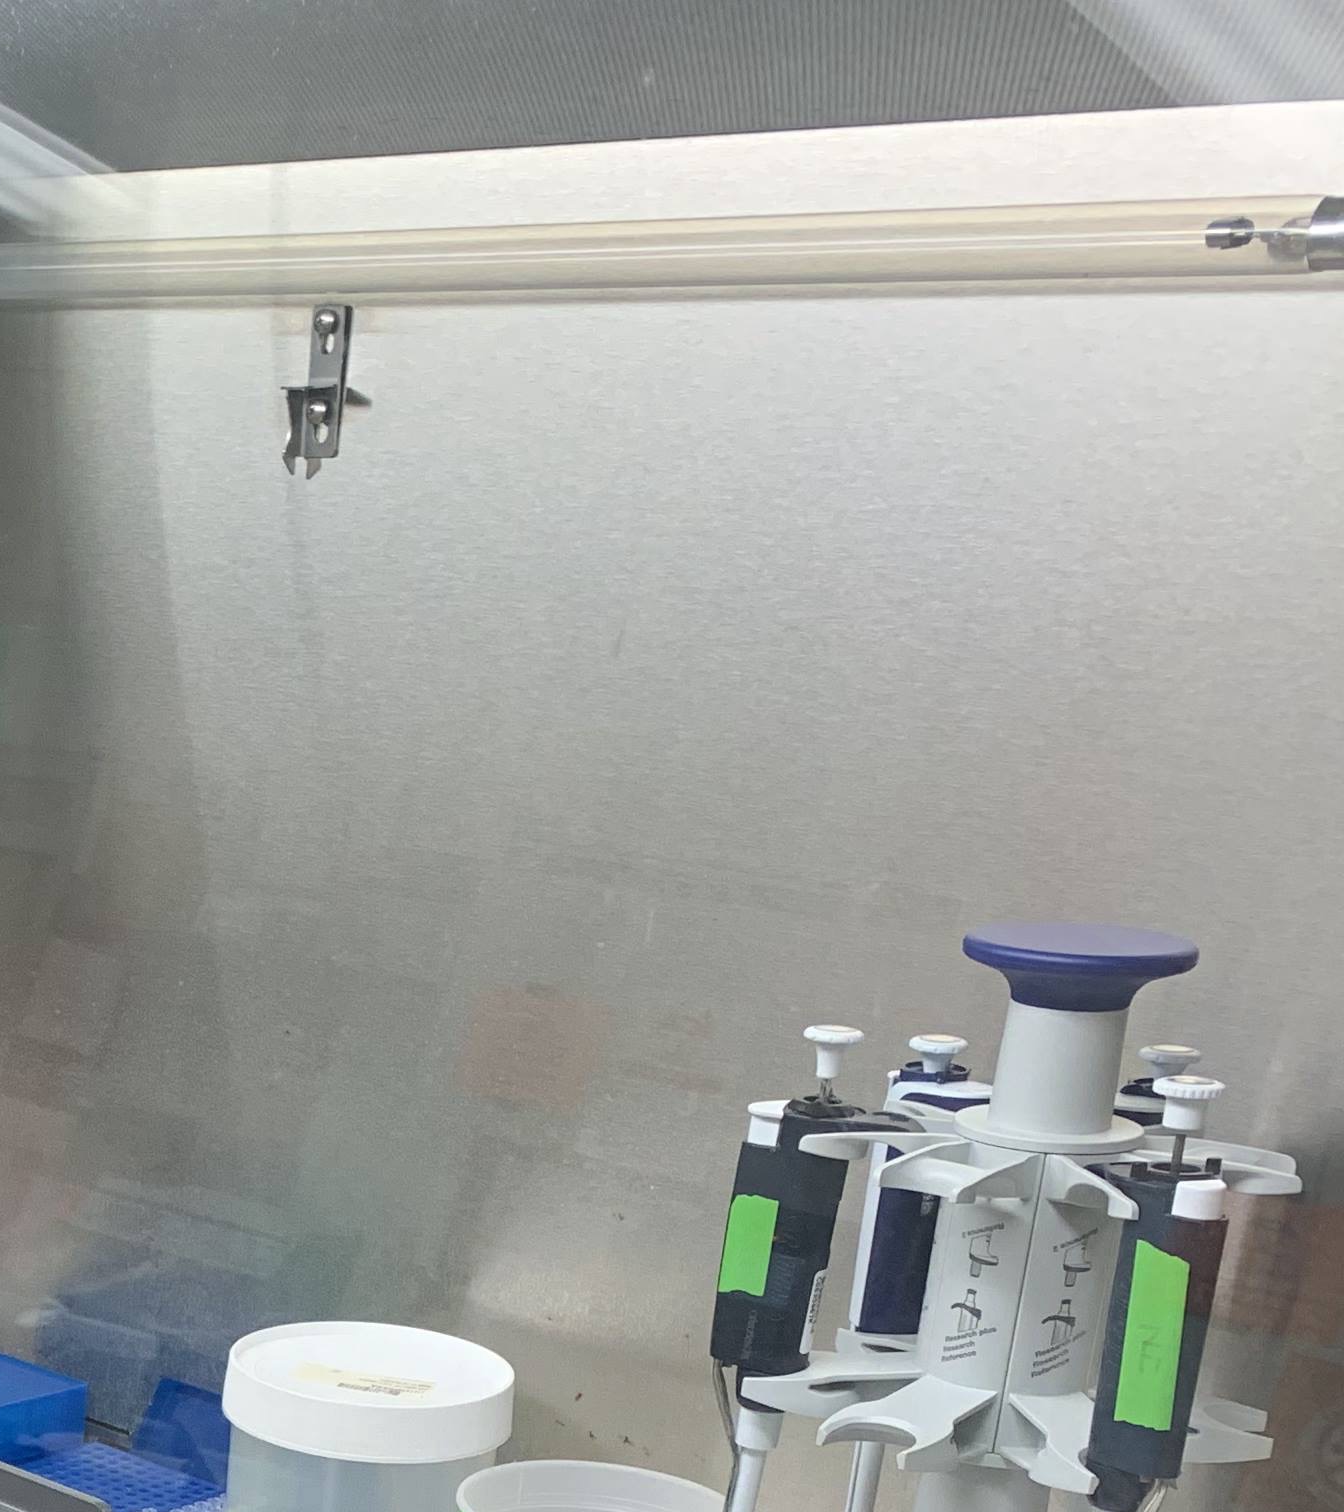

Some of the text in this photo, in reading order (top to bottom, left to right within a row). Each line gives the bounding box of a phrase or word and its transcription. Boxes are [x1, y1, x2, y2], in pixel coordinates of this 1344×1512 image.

[945, 1325, 998, 1343] Research plus
[941, 1350, 977, 1363] Reference
